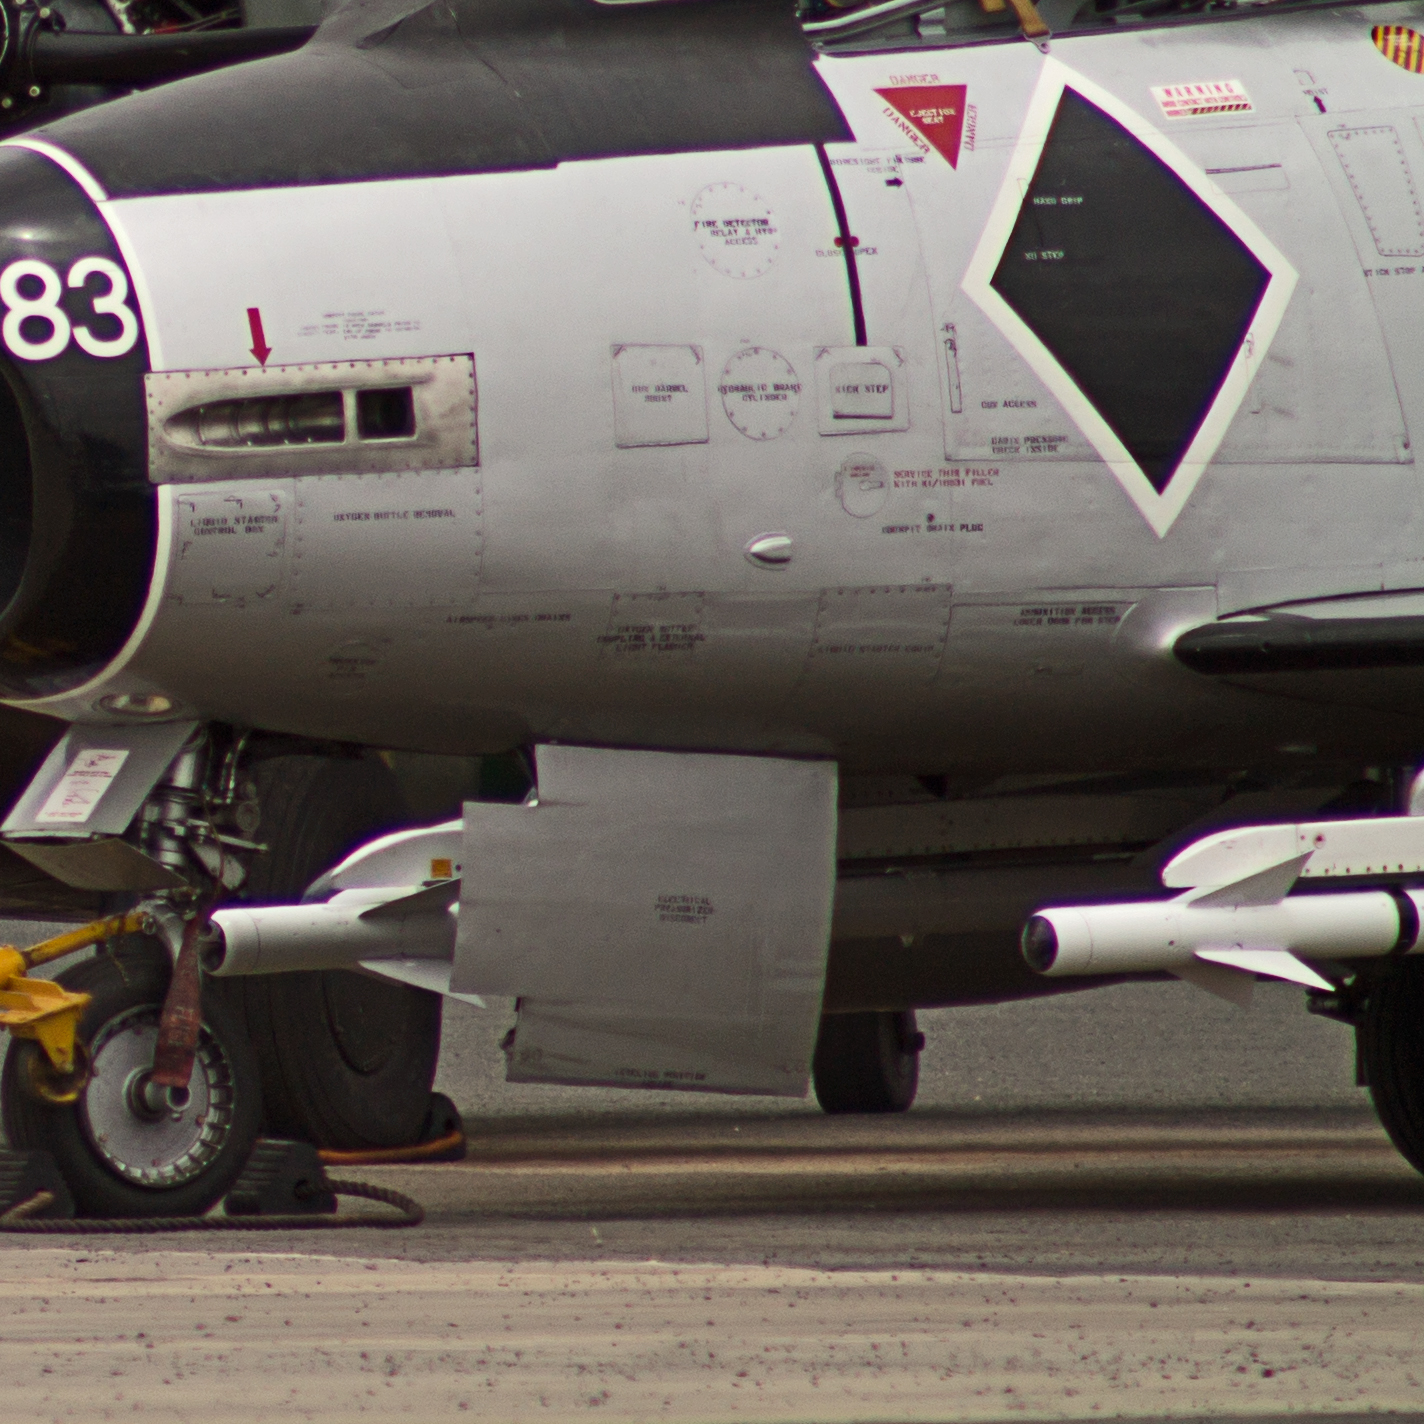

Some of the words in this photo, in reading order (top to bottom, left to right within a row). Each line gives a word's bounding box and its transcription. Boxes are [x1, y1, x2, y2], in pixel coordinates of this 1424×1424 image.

[1162, 82, 1235, 98] WARNING
[882, 107, 931, 154] DANGER
[865, 384, 889, 393] STEP
[965, 468, 1000, 476] FILLER
[959, 523, 984, 532] PLUG
